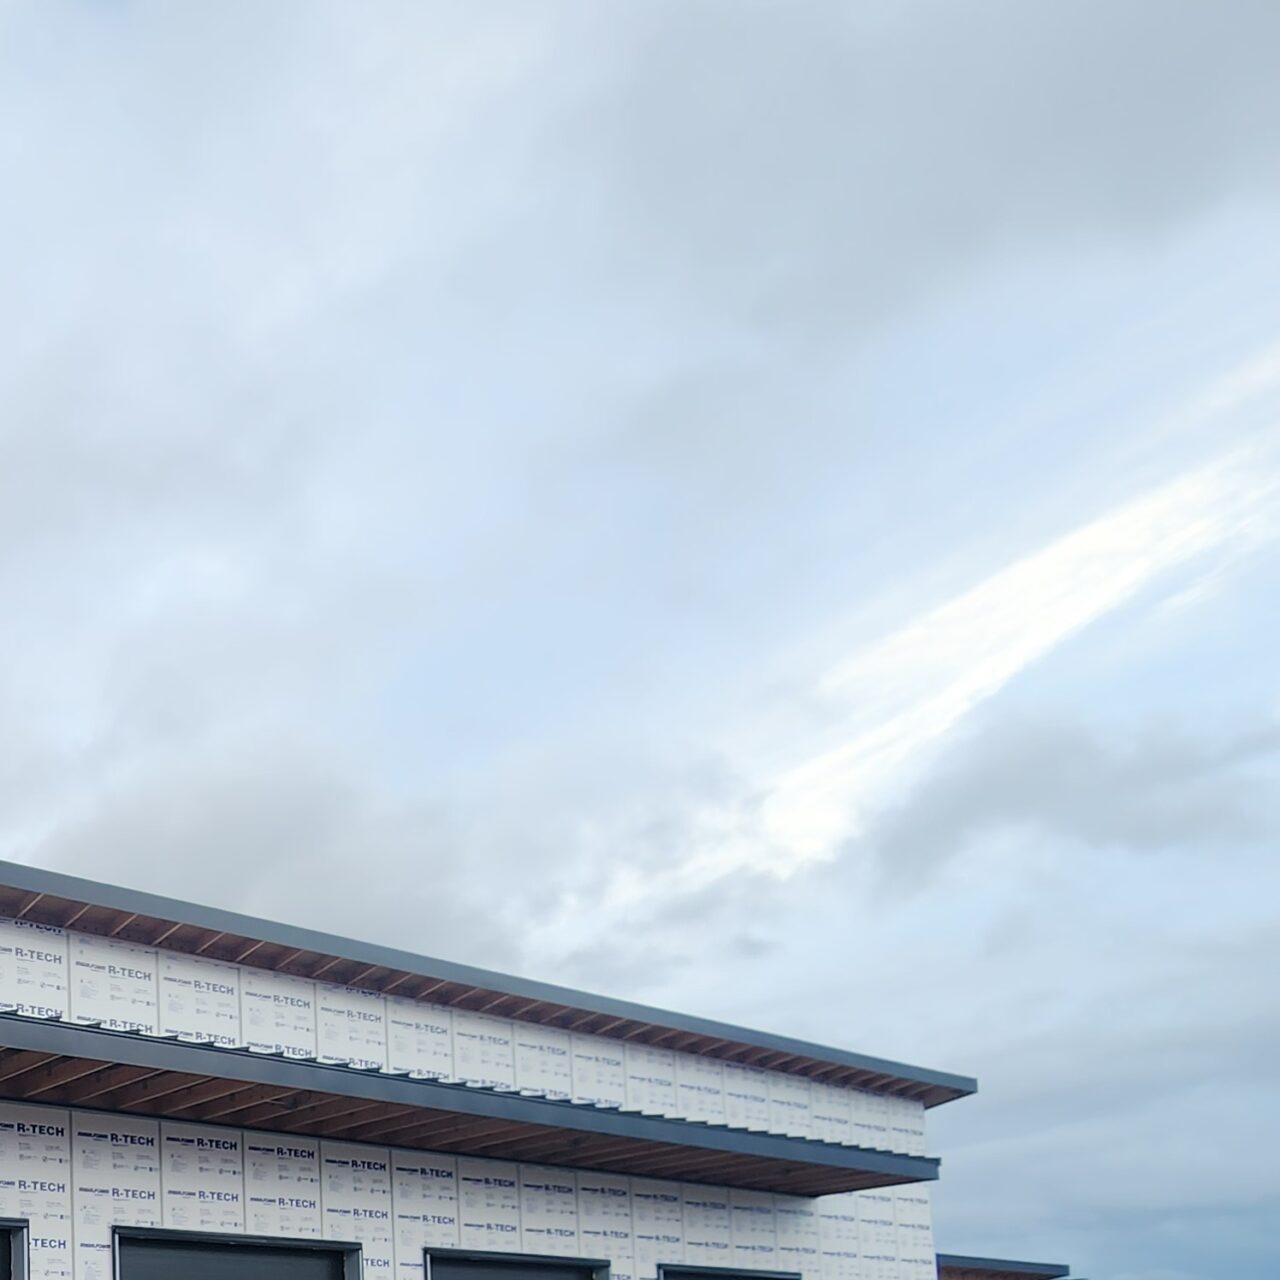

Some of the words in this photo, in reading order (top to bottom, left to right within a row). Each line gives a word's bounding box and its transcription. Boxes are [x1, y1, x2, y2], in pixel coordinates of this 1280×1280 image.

[15, 947, 62, 964] R-TECH
[275, 1044, 312, 1058] RTECH
[17, 1123, 64, 1137] R-TECH
[18, 1180, 65, 1193] R-TECH
